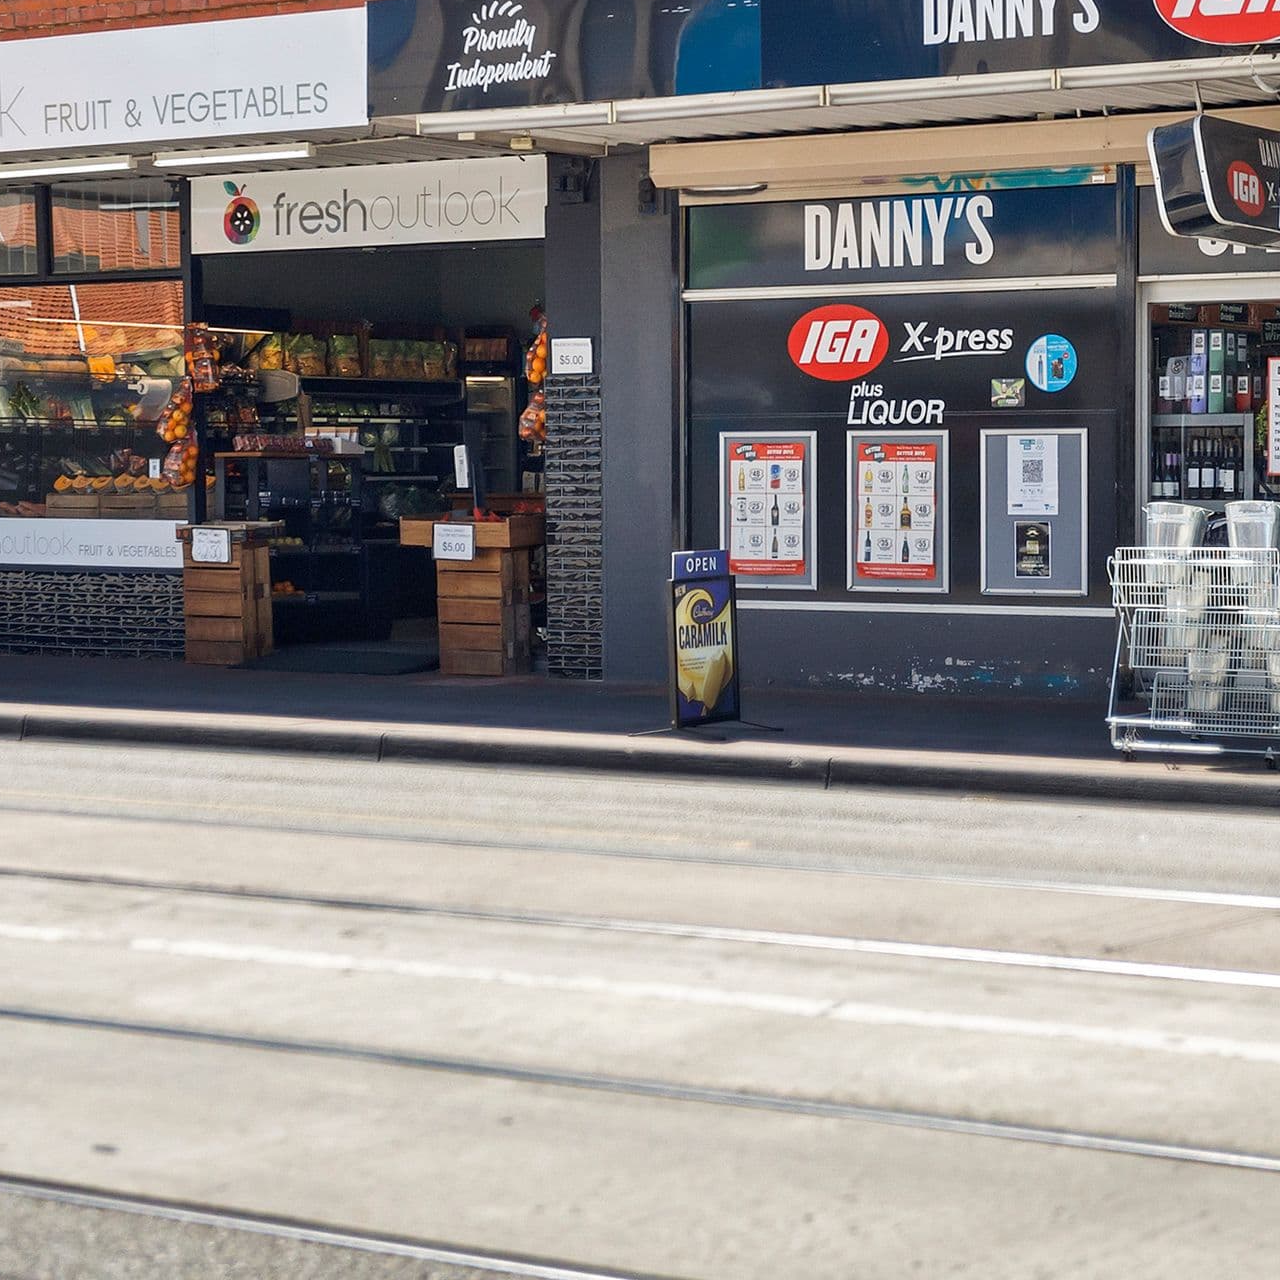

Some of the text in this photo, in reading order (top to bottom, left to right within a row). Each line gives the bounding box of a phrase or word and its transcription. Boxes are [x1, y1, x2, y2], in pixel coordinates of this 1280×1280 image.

[463, 19, 536, 54] Proudly
[444, 50, 557, 93] Independent
[44, 99, 112, 135] FRUIT
[124, 99, 143, 129] &
[153, 81, 329, 126] VEGETABLES
[1233, 170, 1260, 206] IGA
[804, 195, 995, 271] DANNY'S
[799, 319, 1014, 365] IGA X-press
[560, 354, 584, 365] $5.00
[850, 380, 884, 401] plus
[847, 399, 946, 425] LIQUOR
[78, 544, 103, 557] FRUIT
[106, 544, 114, 557] &
[117, 544, 177, 558] VEGETABLES
[442, 541, 466, 552] $5.00
[686, 556, 717, 573] OPEN
[678, 621, 728, 650] CARAMILK
